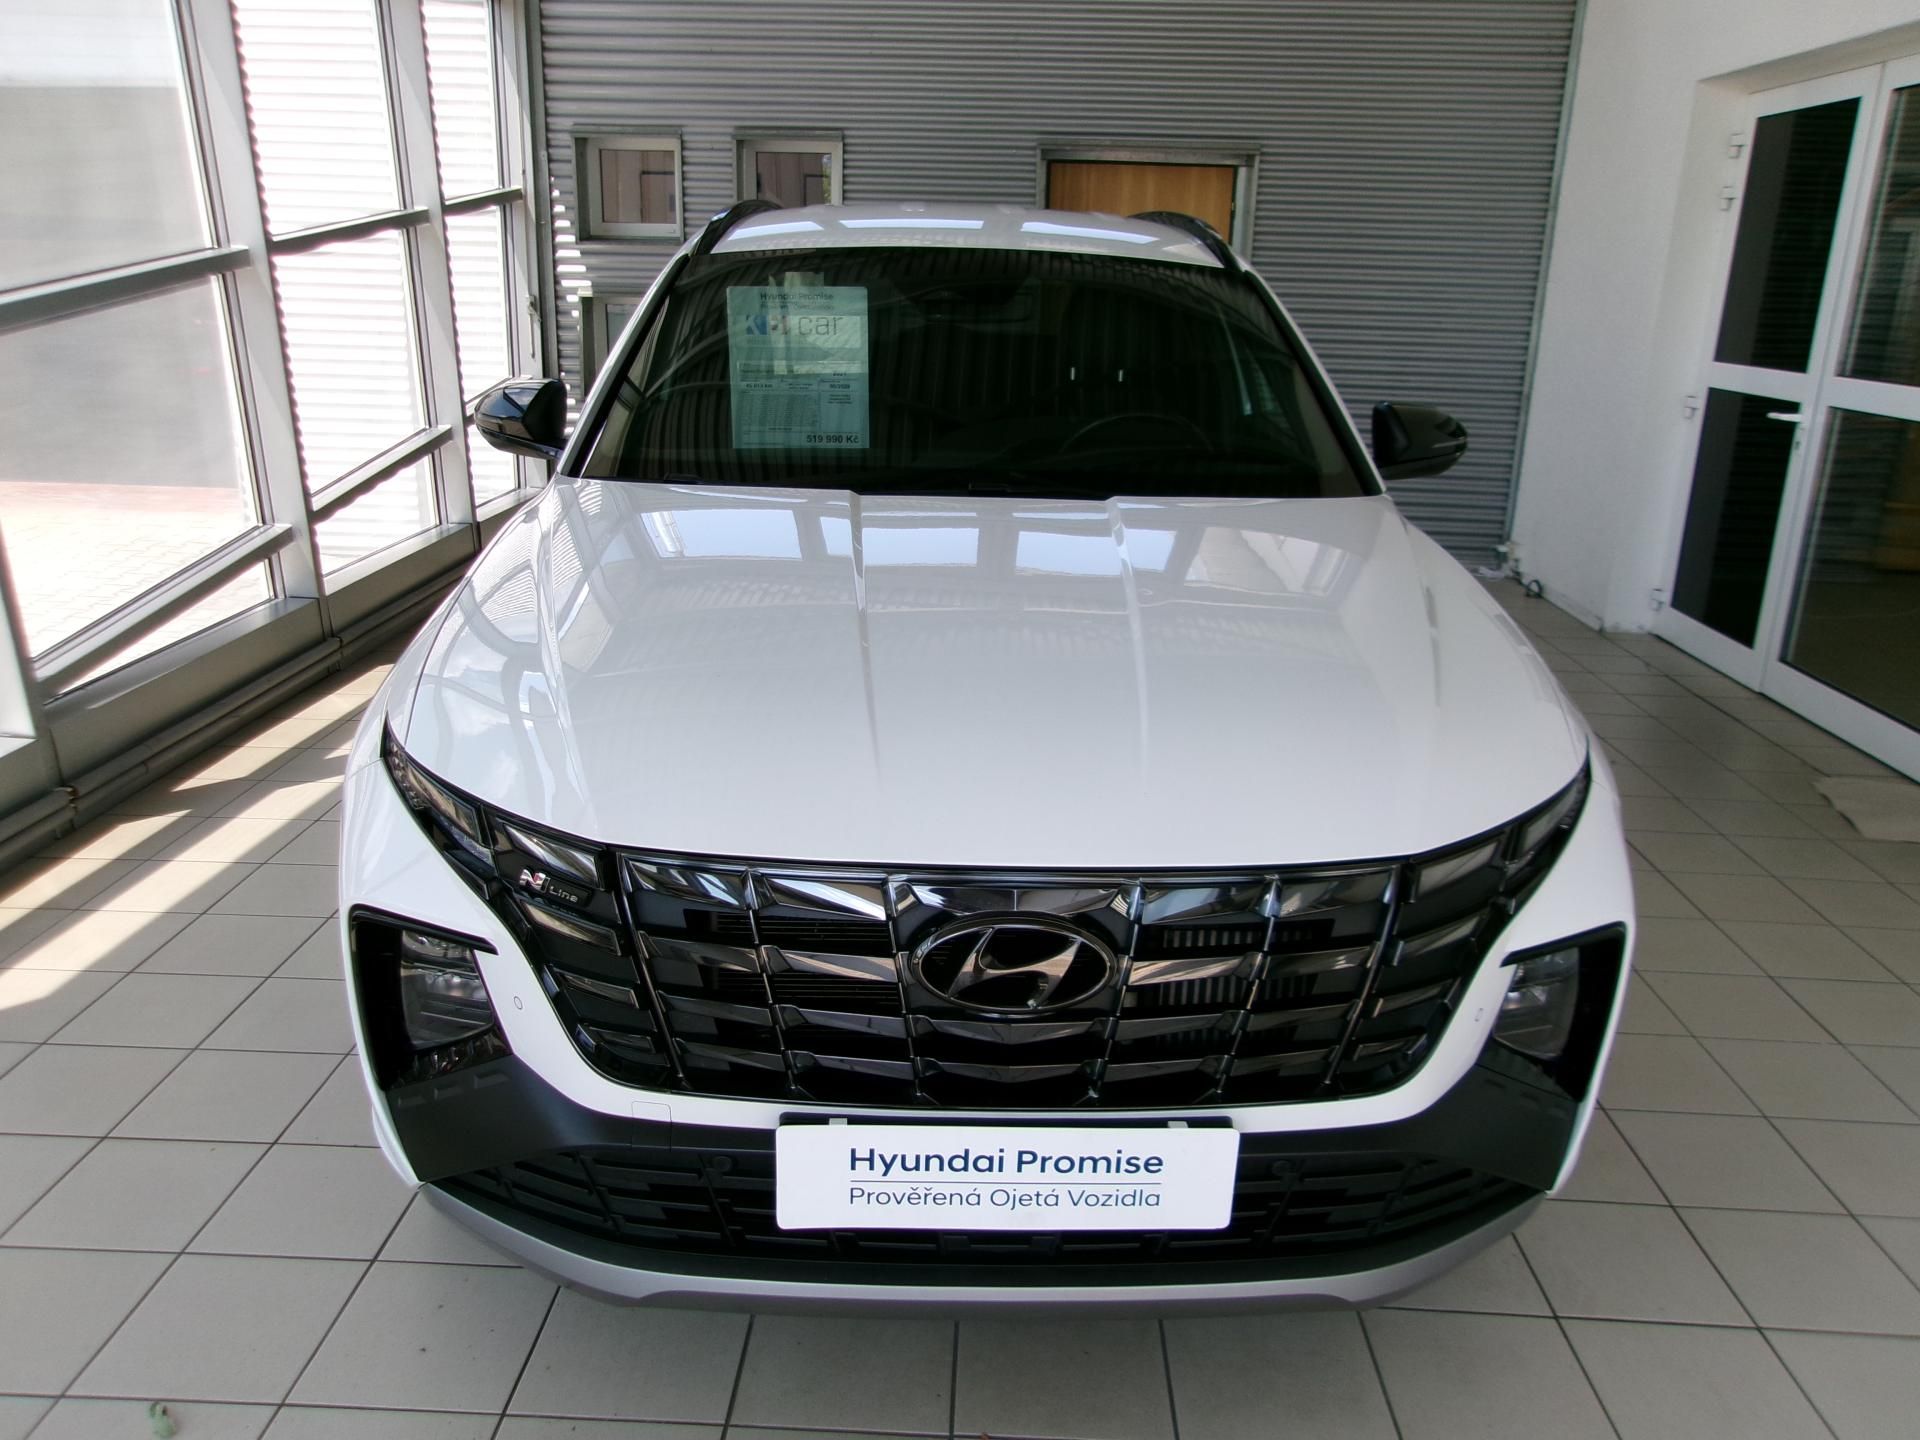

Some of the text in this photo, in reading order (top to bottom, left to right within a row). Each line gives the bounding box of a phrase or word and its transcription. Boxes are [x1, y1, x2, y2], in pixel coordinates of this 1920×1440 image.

[798, 316, 844, 336] car
[806, 434, 859, 443] 519 990 Kč
[549, 886, 579, 903] Line
[850, 1147, 1164, 1177] Hyundai Promise
[850, 1186, 1161, 1210] Prověřená Ojetá Vozidla
